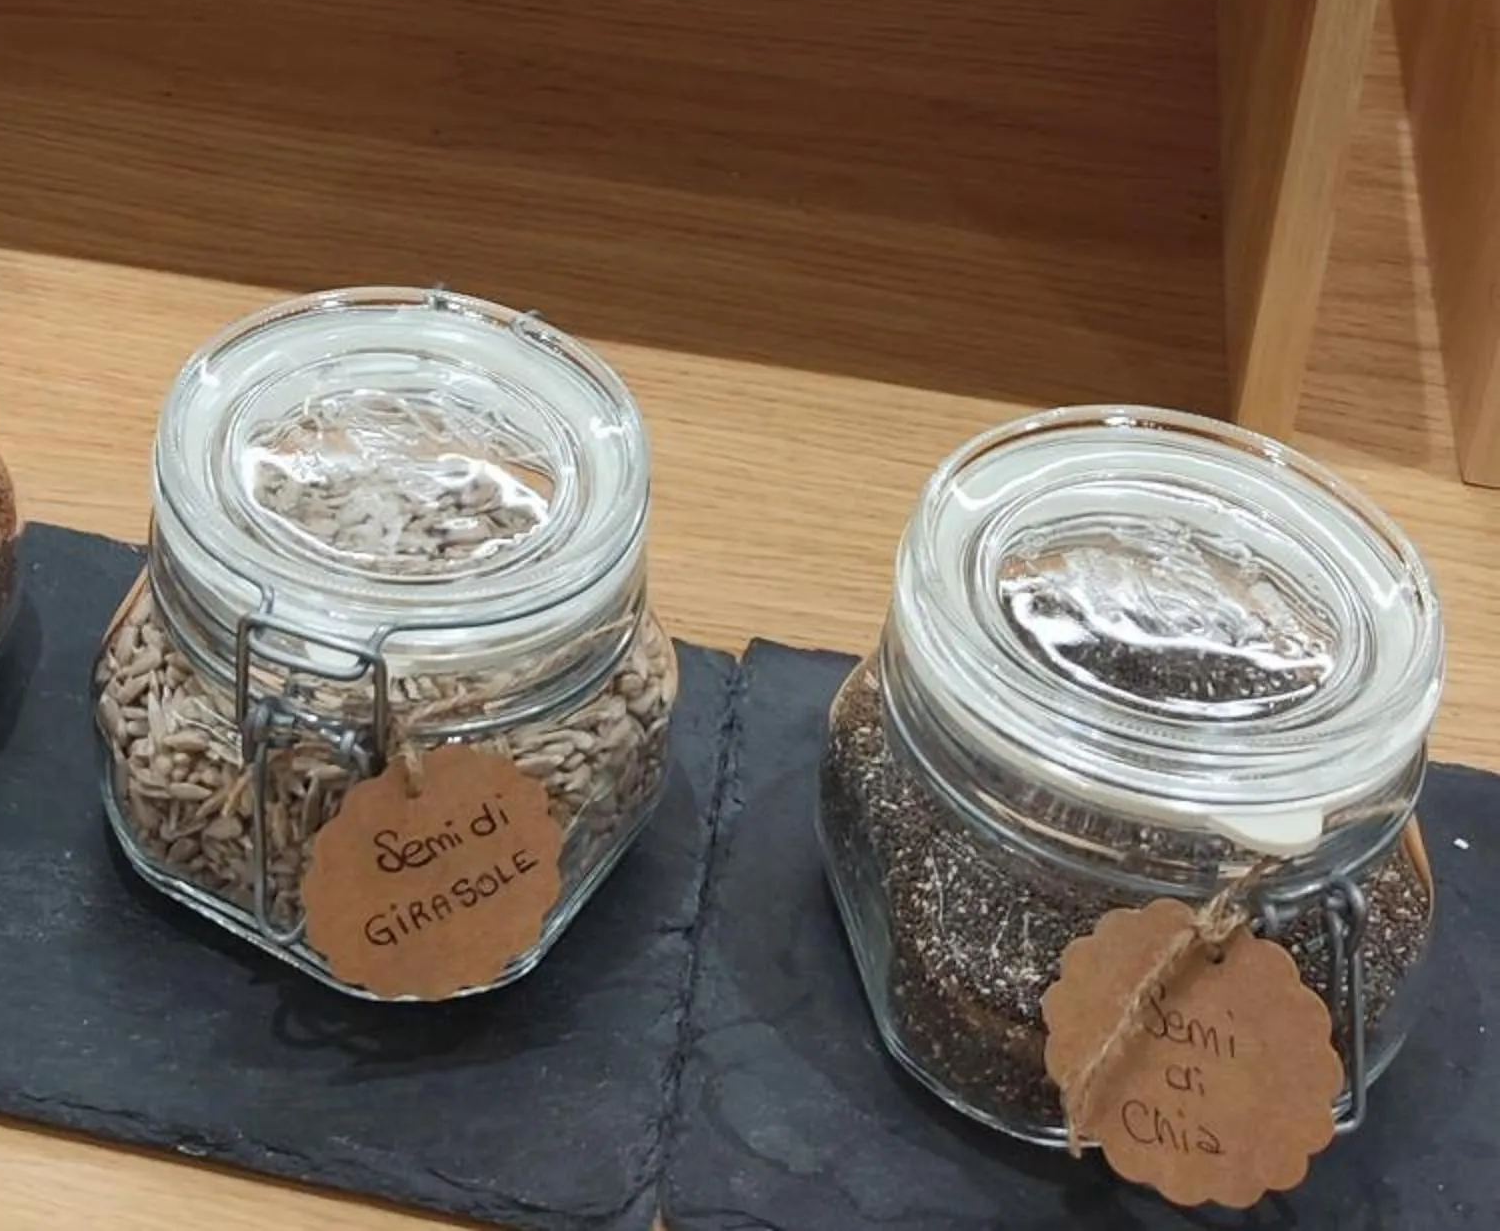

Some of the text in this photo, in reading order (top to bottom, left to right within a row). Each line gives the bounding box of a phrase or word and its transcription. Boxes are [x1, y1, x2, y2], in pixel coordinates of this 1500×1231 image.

[372, 793, 510, 874] Semi di
[1143, 983, 1236, 1059] Semi
[1165, 1064, 1206, 1097] di
[1121, 1099, 1226, 1156] Chia
